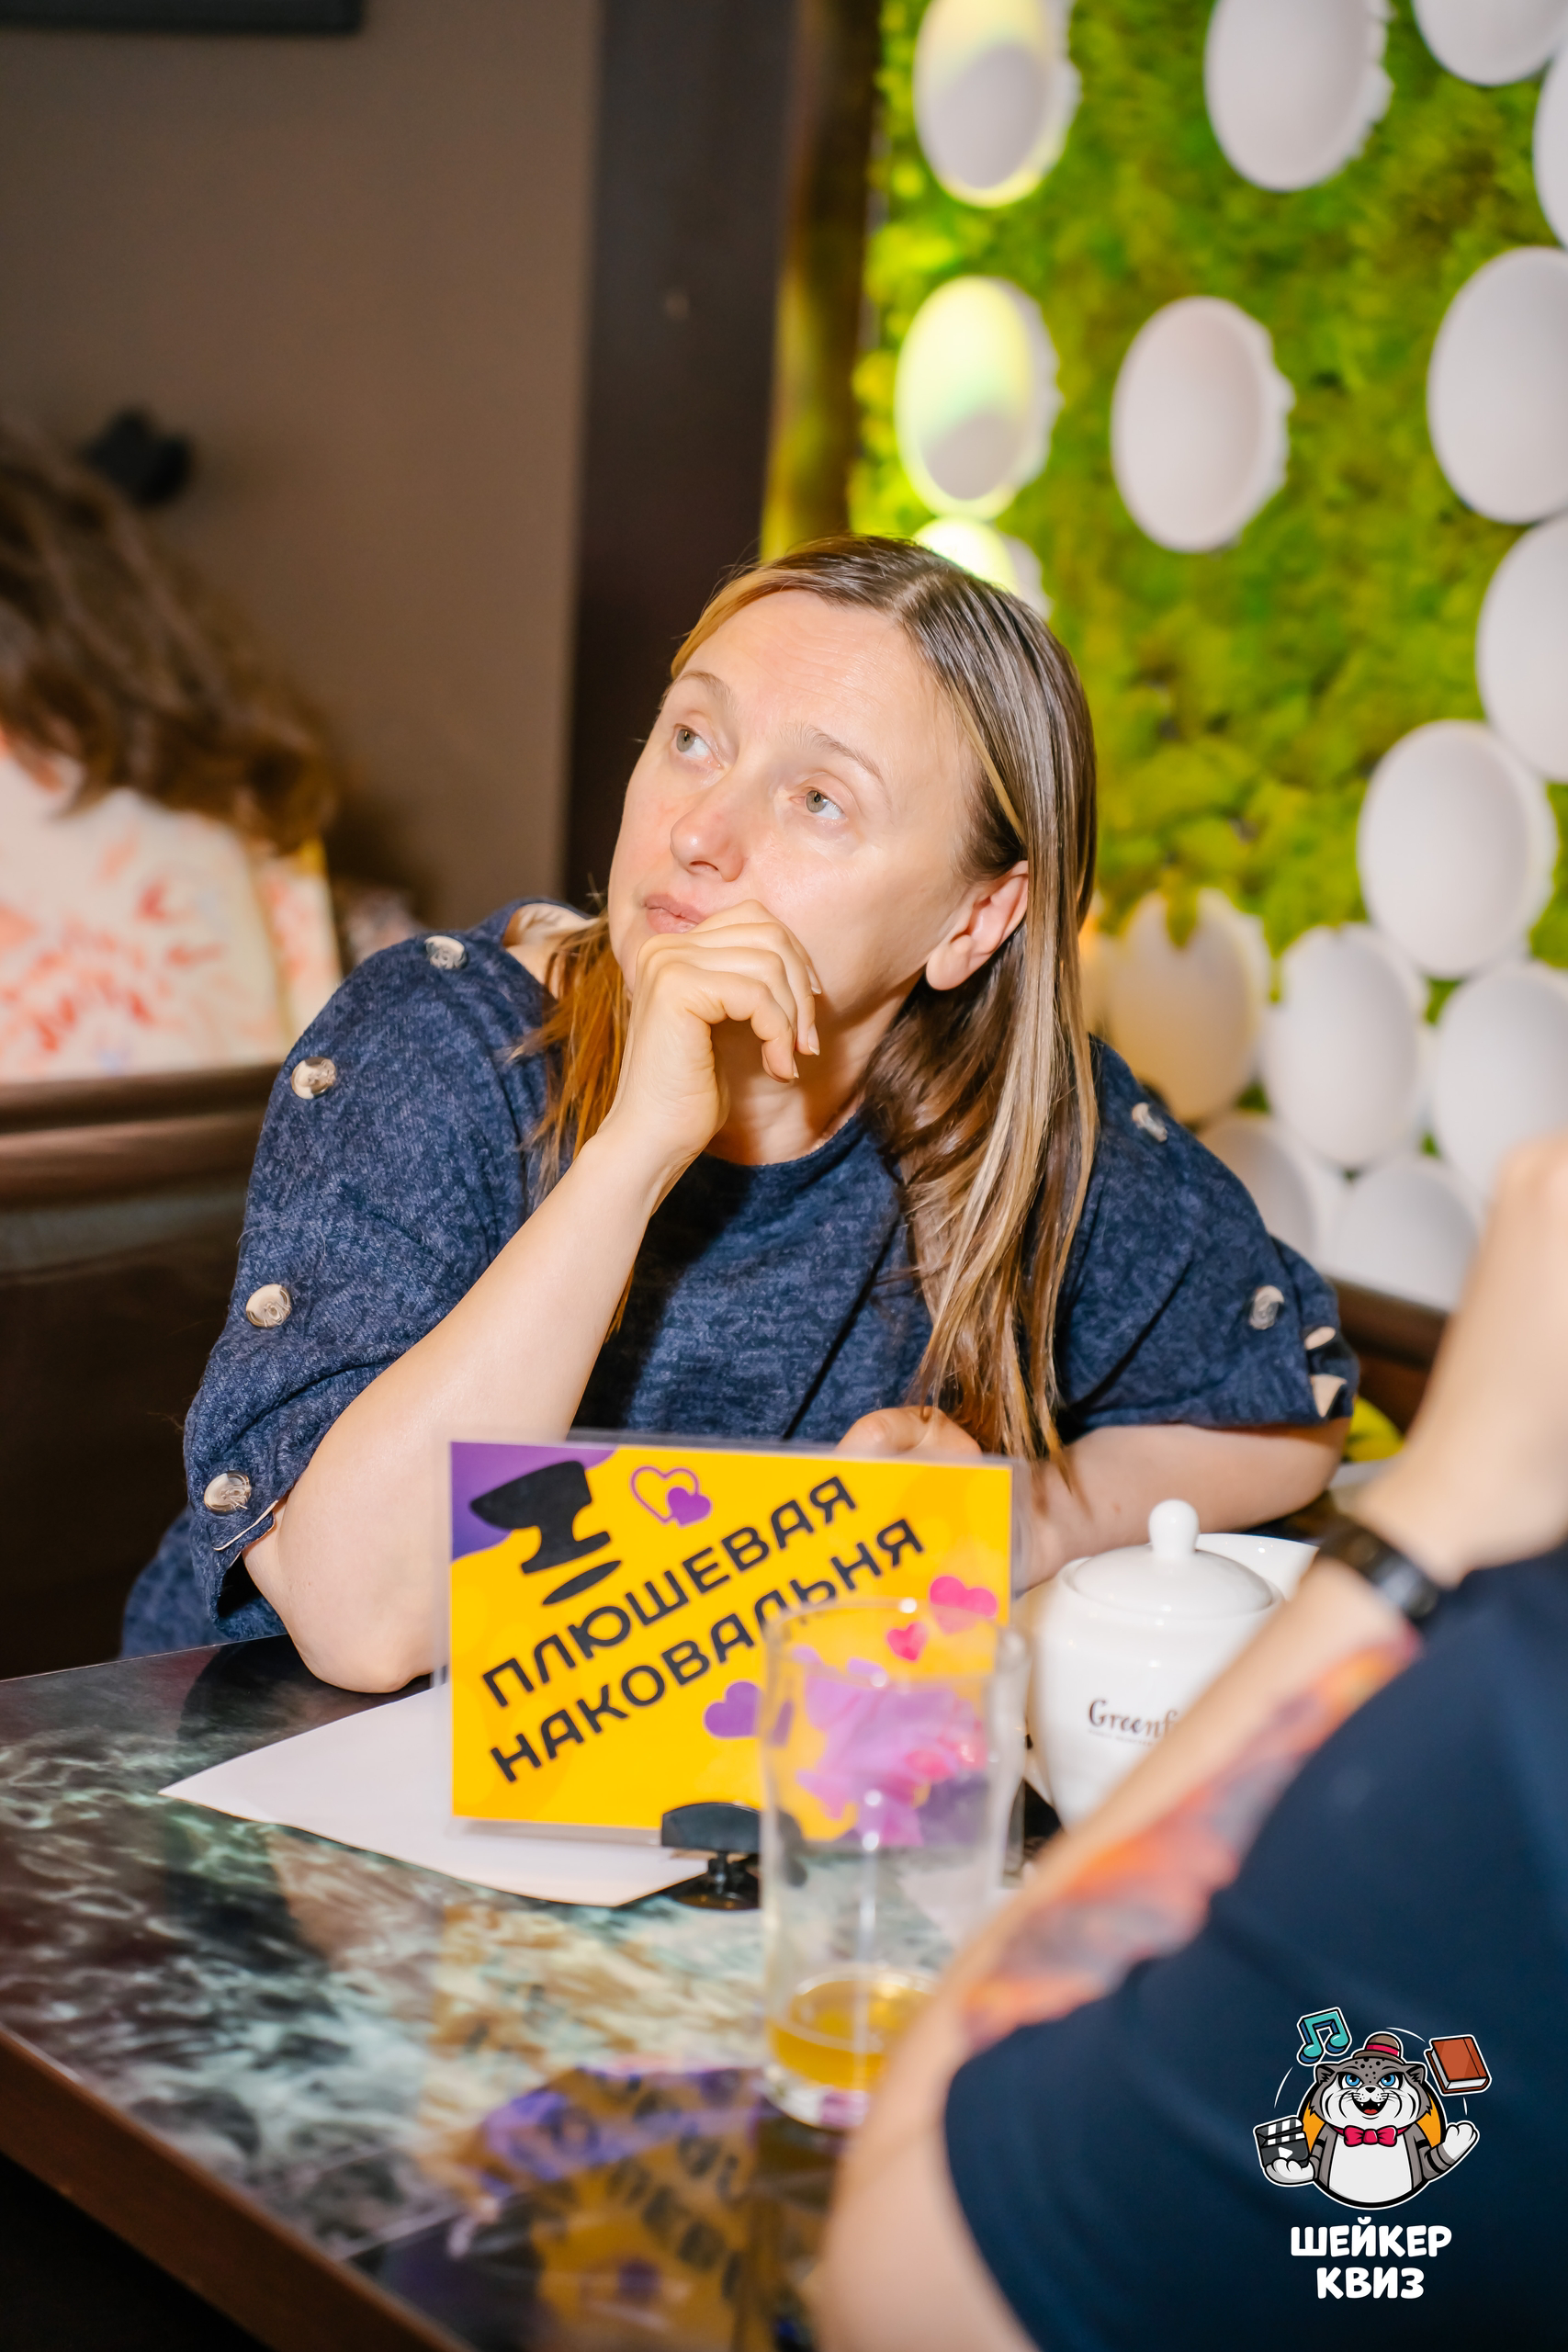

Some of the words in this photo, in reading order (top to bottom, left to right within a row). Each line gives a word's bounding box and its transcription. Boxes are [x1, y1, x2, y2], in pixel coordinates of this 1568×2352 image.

[481, 1475, 859, 1708] ПЛЮШЕВАЯ
[489, 1518, 926, 1783] НАКОВАЛЬНЯ
[1089, 1699, 1179, 1739] Greenf
